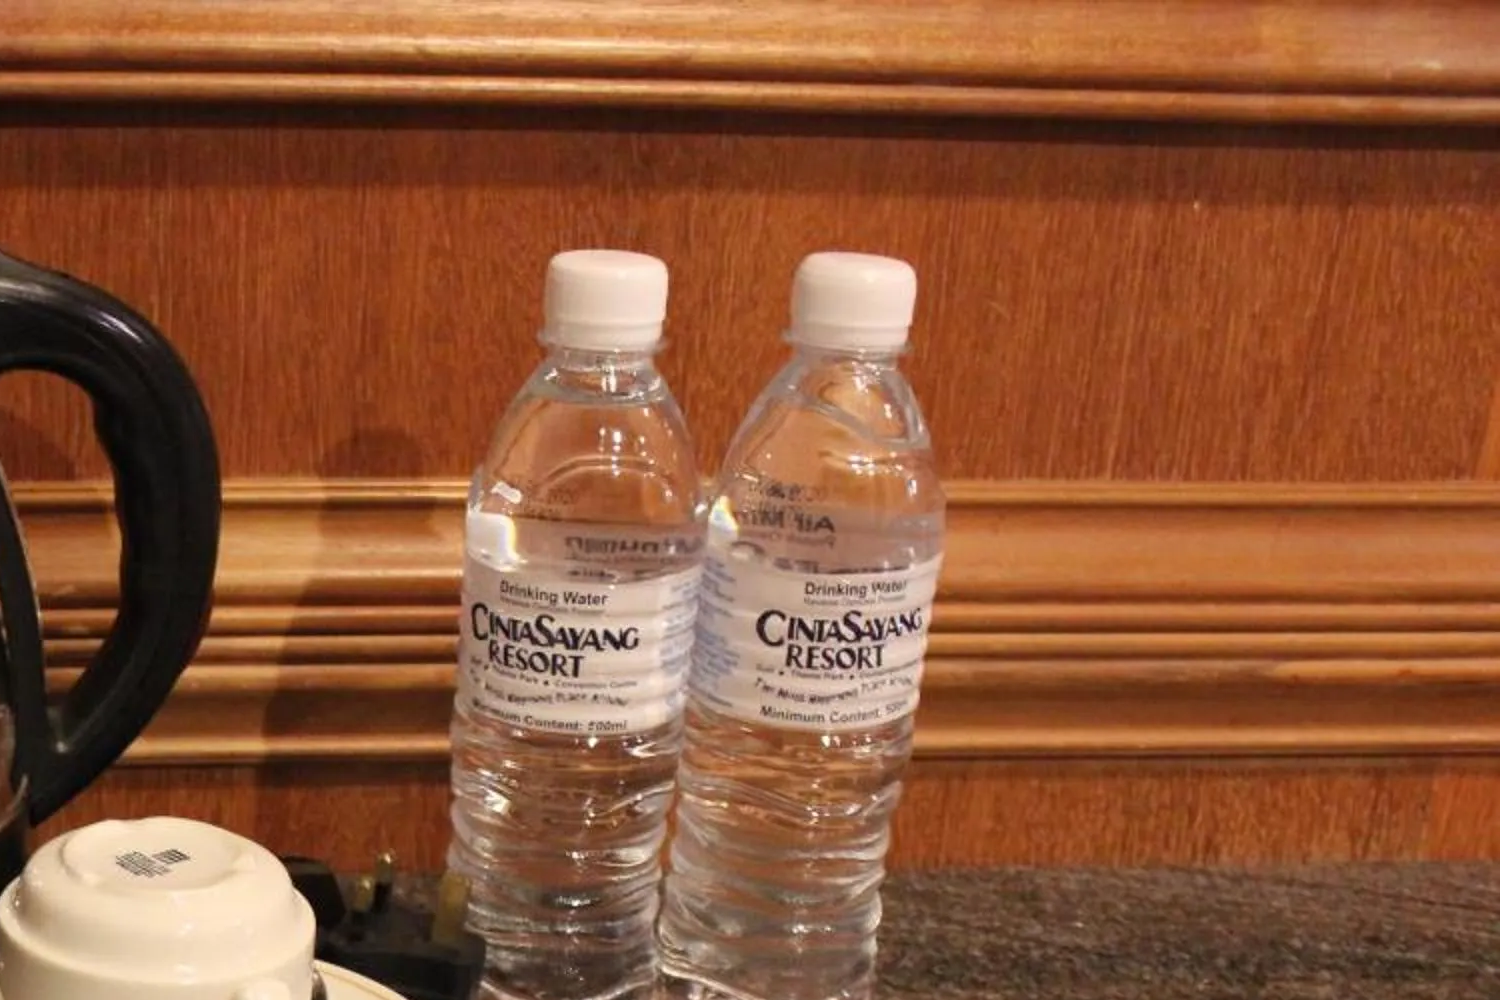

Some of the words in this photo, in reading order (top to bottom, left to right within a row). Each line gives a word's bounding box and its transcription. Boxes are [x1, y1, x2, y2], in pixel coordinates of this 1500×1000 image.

[500, 579, 559, 606] Drinking
[563, 591, 608, 606] Water
[804, 581, 867, 598] Drinking
[489, 639, 586, 678] RESORT
[785, 643, 885, 670] RESORT
[760, 705, 826, 723] Minimum
